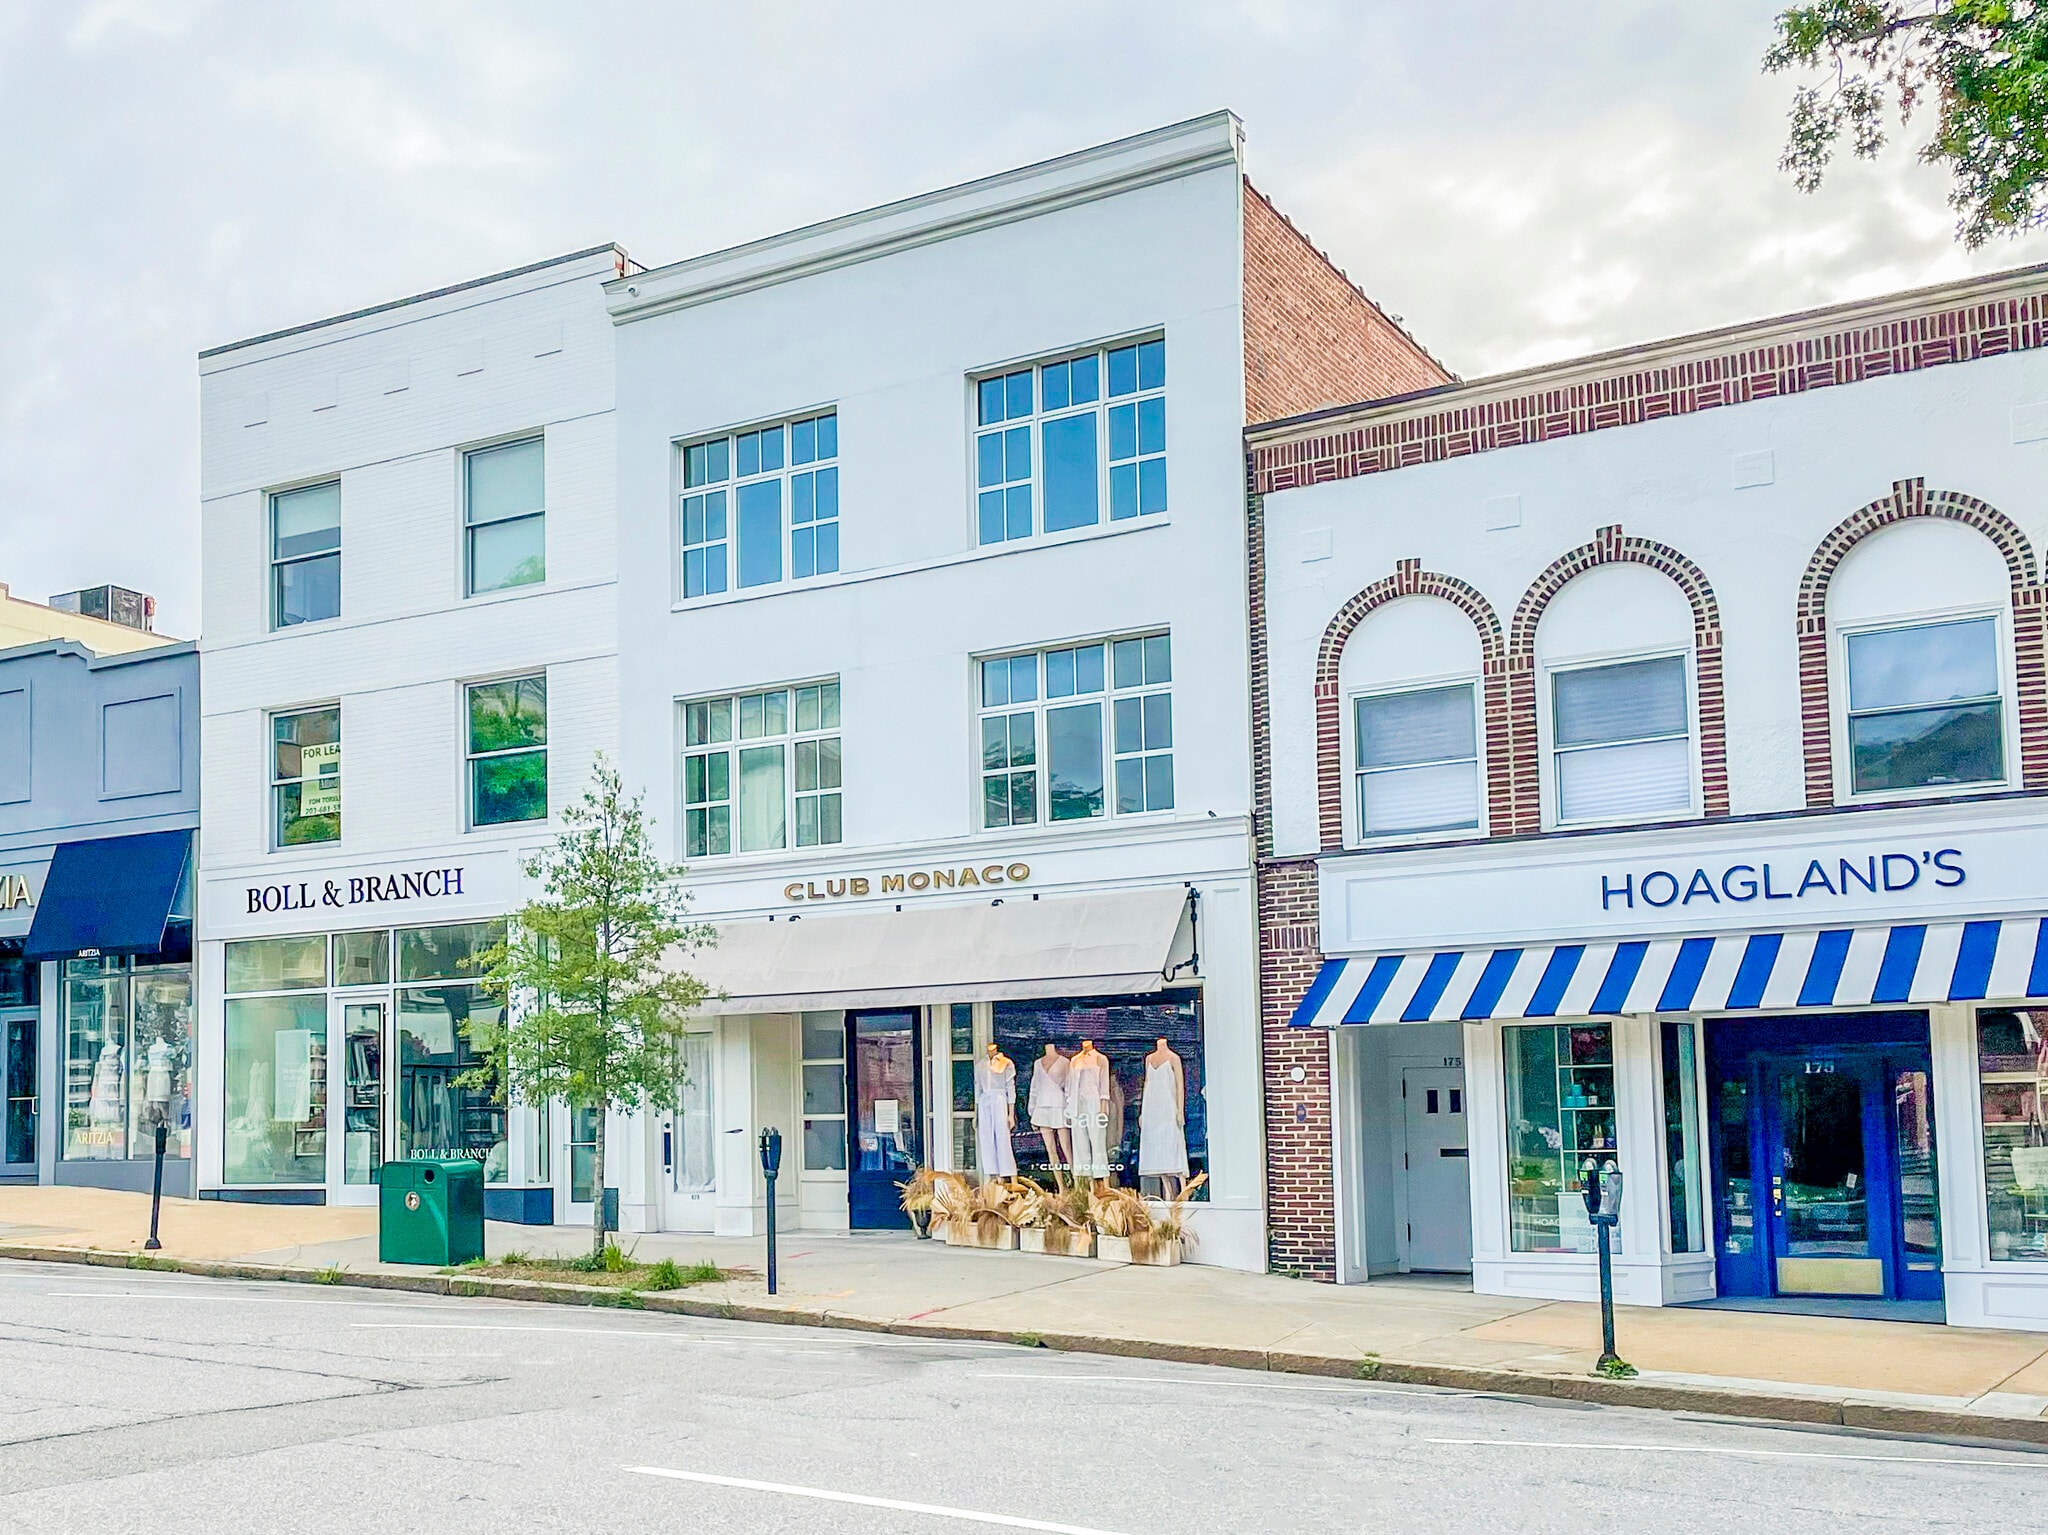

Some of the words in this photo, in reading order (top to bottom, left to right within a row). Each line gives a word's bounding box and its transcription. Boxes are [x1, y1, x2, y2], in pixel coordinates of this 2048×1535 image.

[303, 748, 321, 759] FOR
[784, 878, 870, 900] CLUB
[881, 862, 1031, 893] MONACO
[1602, 848, 1967, 911] HOAGLAND'S
[246, 883, 316, 913] BOLL
[322, 880, 344, 908] &
[348, 867, 465, 904] BRANCH
[1443, 1057, 1462, 1067] 175
[1805, 1062, 1835, 1074] 175
[75, 1131, 114, 1145] ARITZIA
[410, 1148, 438, 1160] BOLL
[440, 1148, 449, 1160] &
[450, 1147, 493, 1159] BRANCH
[1039, 1163, 1071, 1171] CLUB
[1075, 1163, 1125, 1171] MONACO
